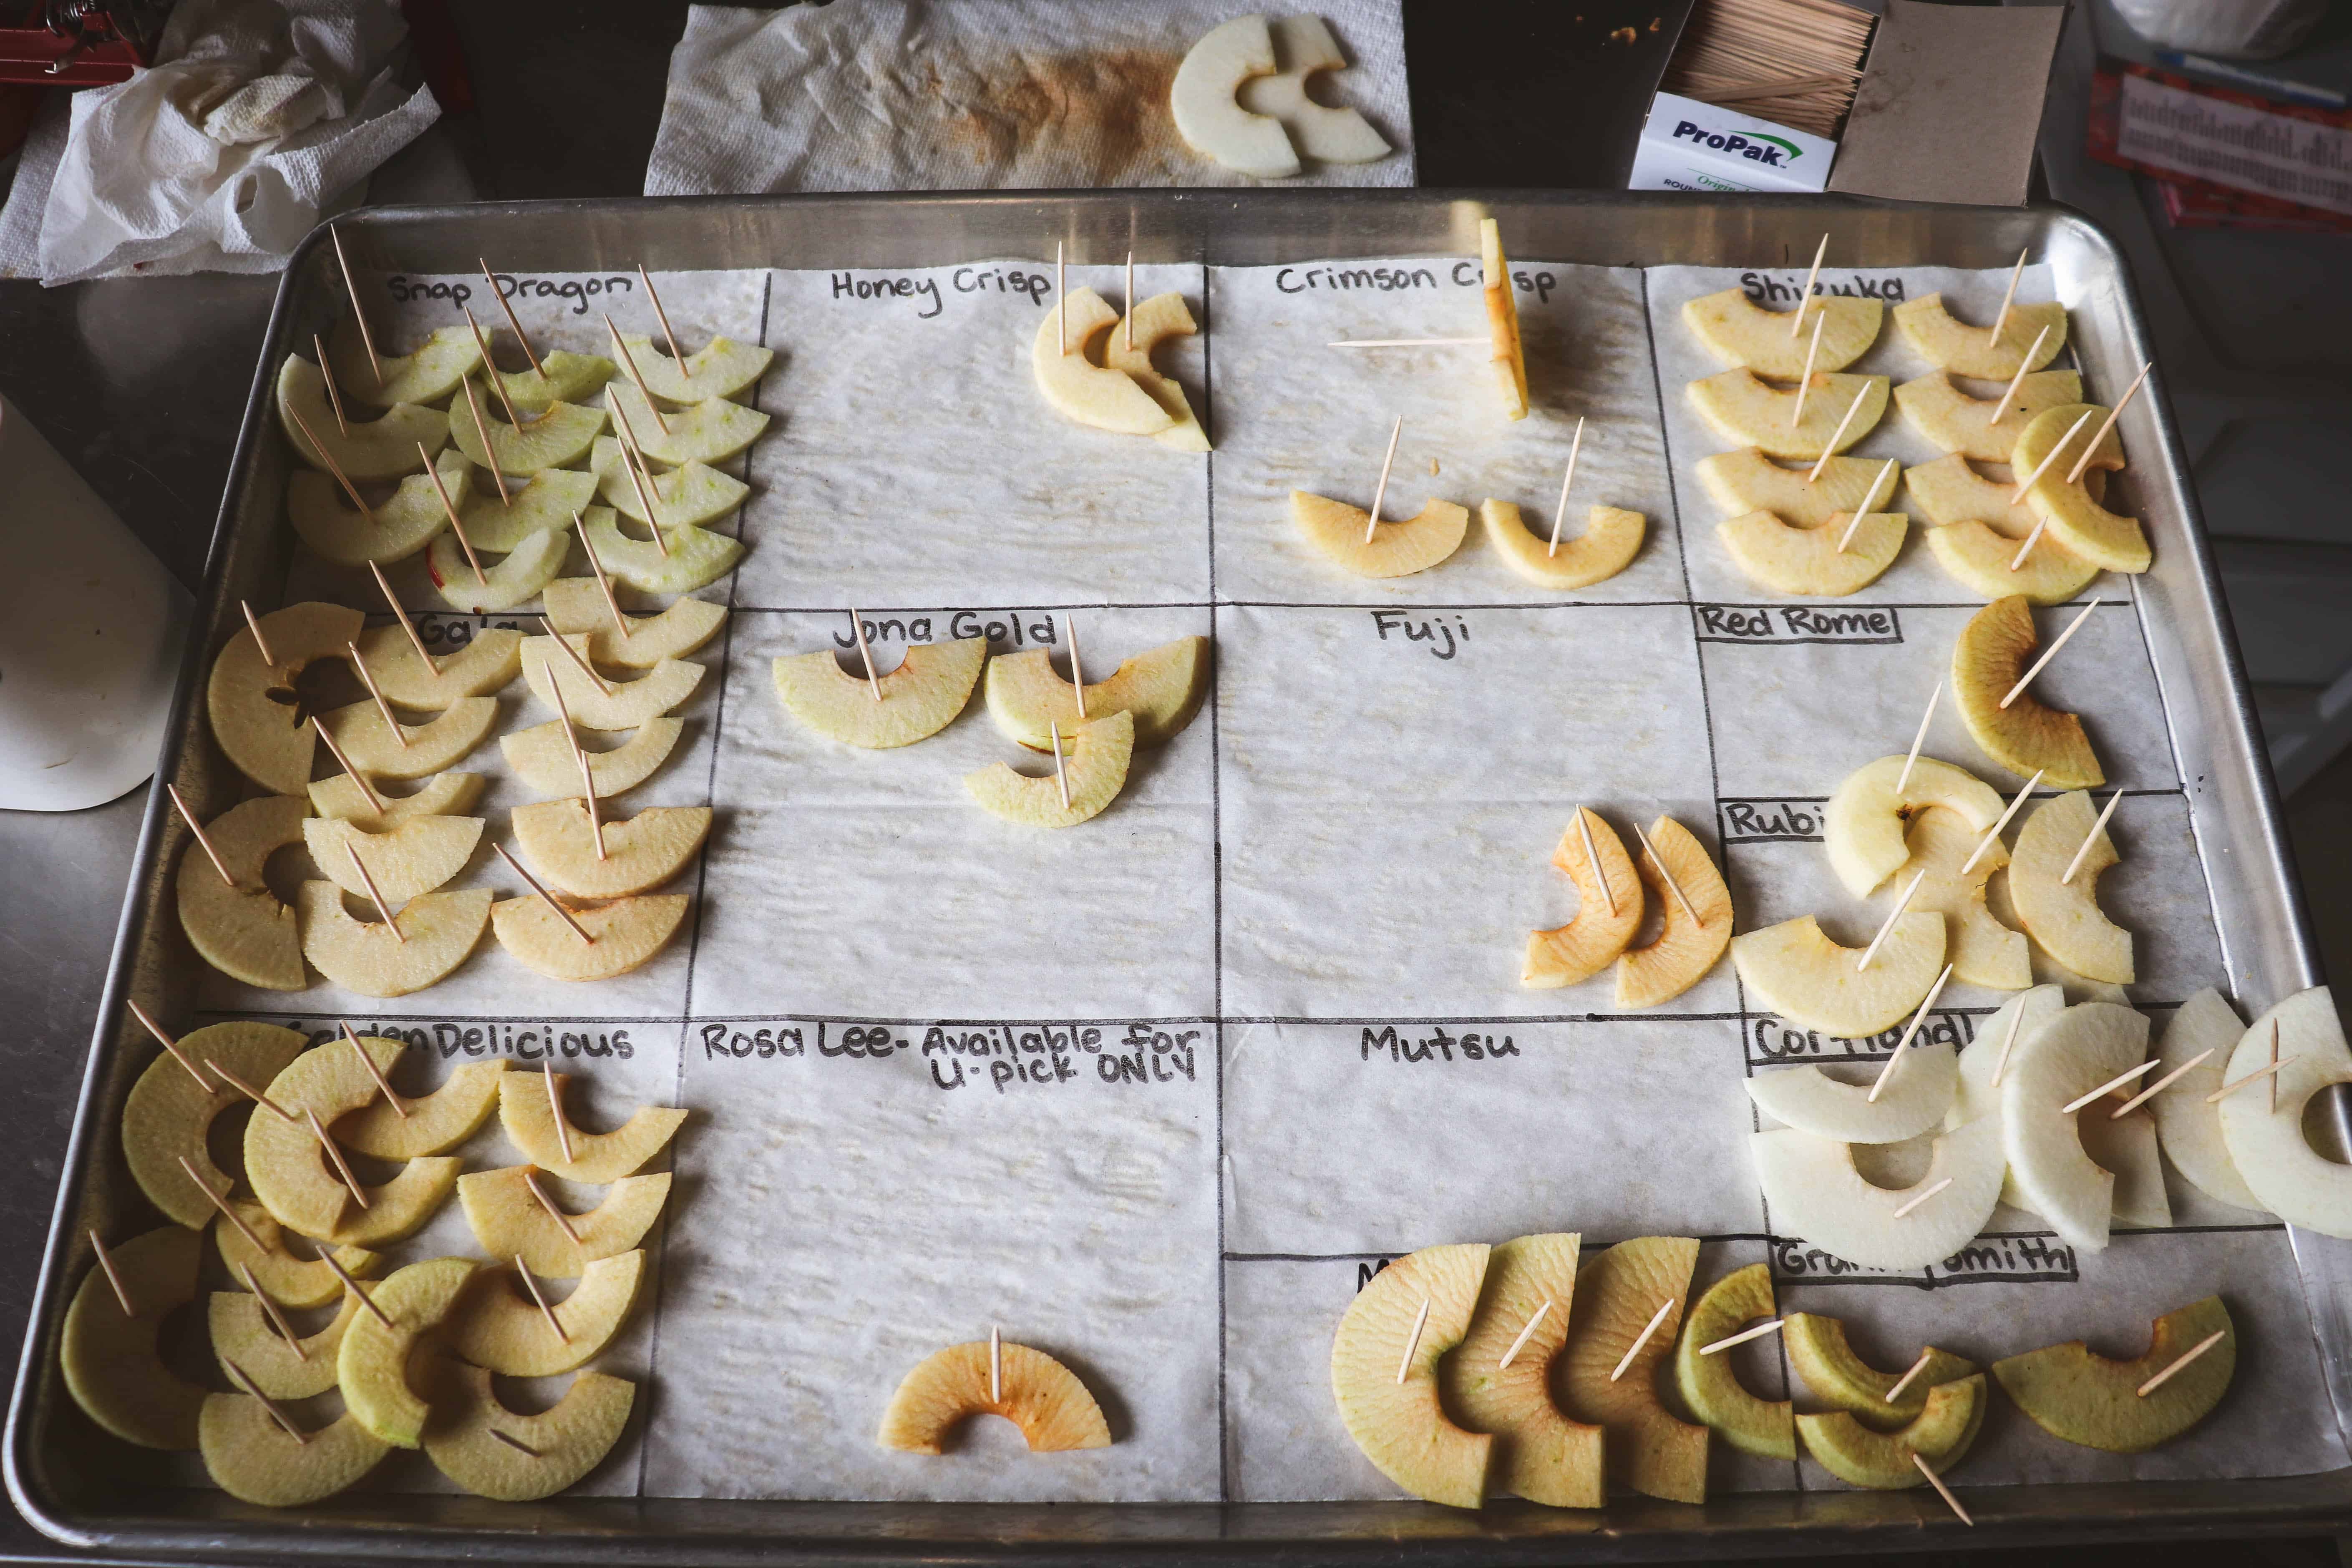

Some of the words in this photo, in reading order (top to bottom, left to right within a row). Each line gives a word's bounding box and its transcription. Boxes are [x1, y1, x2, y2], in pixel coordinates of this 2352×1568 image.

[1664, 179, 1702, 191] ROU
[1697, 176, 1749, 191] Origin
[387, 275, 472, 310] Snap
[485, 274, 632, 314] Dragon
[832, 272, 943, 319] Honey
[953, 267, 1051, 307] Crisp
[1276, 267, 1438, 293] Crimson
[1451, 262, 1557, 304] Csp
[833, 609, 932, 648] Jona
[950, 611, 1057, 645] Gold
[1370, 610, 1470, 660] Fuji
[1698, 606, 1775, 637] Red
[1780, 606, 1890, 635] Rome
[287, 1021, 428, 1051] oden
[432, 1023, 635, 1060] Delicious
[700, 1023, 805, 1061] Rosa
[922, 1024, 1102, 1057] Available
[1361, 1026, 1520, 1062] Mutsu
[1098, 1047, 1196, 1084] ONLY
